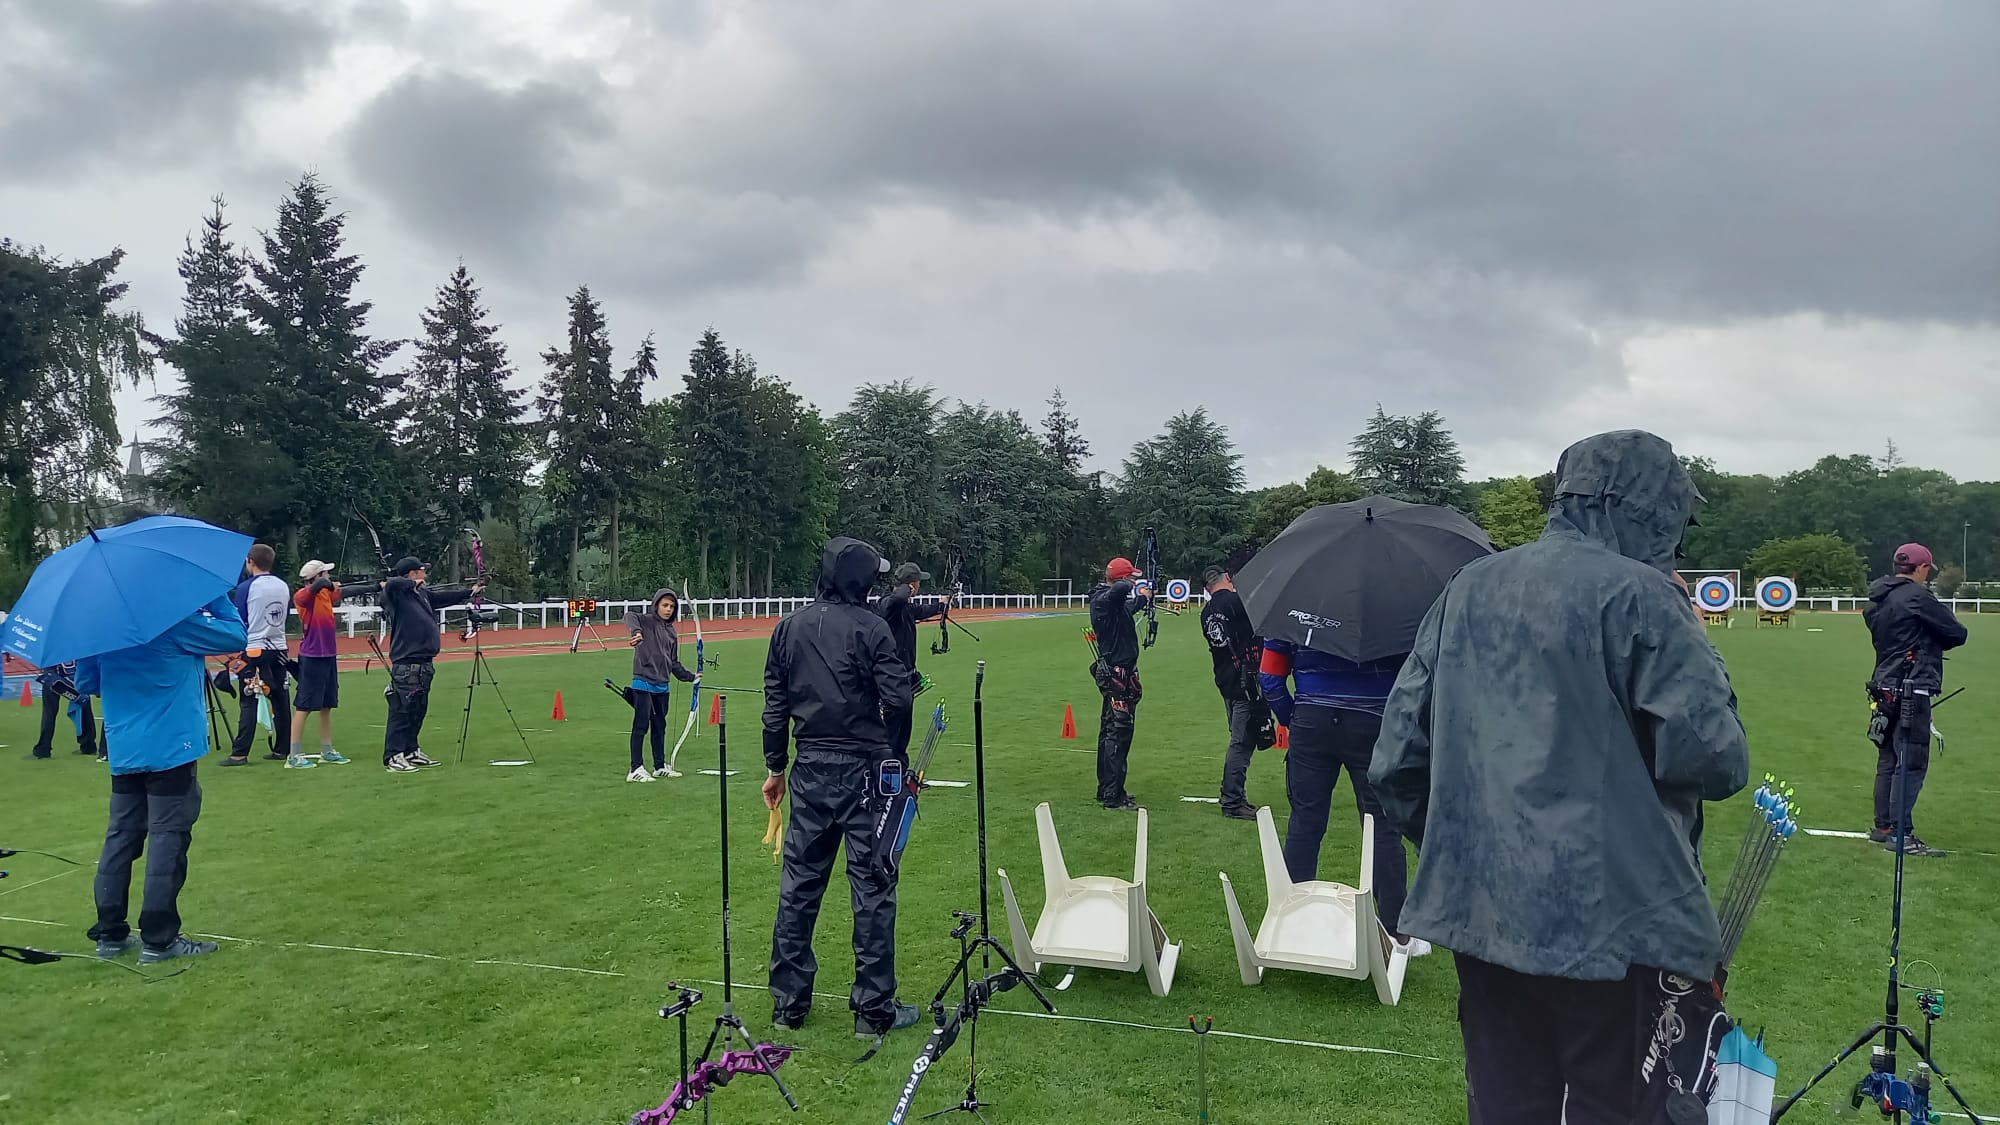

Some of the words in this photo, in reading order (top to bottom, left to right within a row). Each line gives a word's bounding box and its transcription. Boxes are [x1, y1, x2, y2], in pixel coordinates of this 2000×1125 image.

[579, 600, 595, 612] 23
[1711, 615, 1720, 625] 14
[1771, 616, 1782, 625] 15
[892, 1073, 919, 1125] FIVICS
